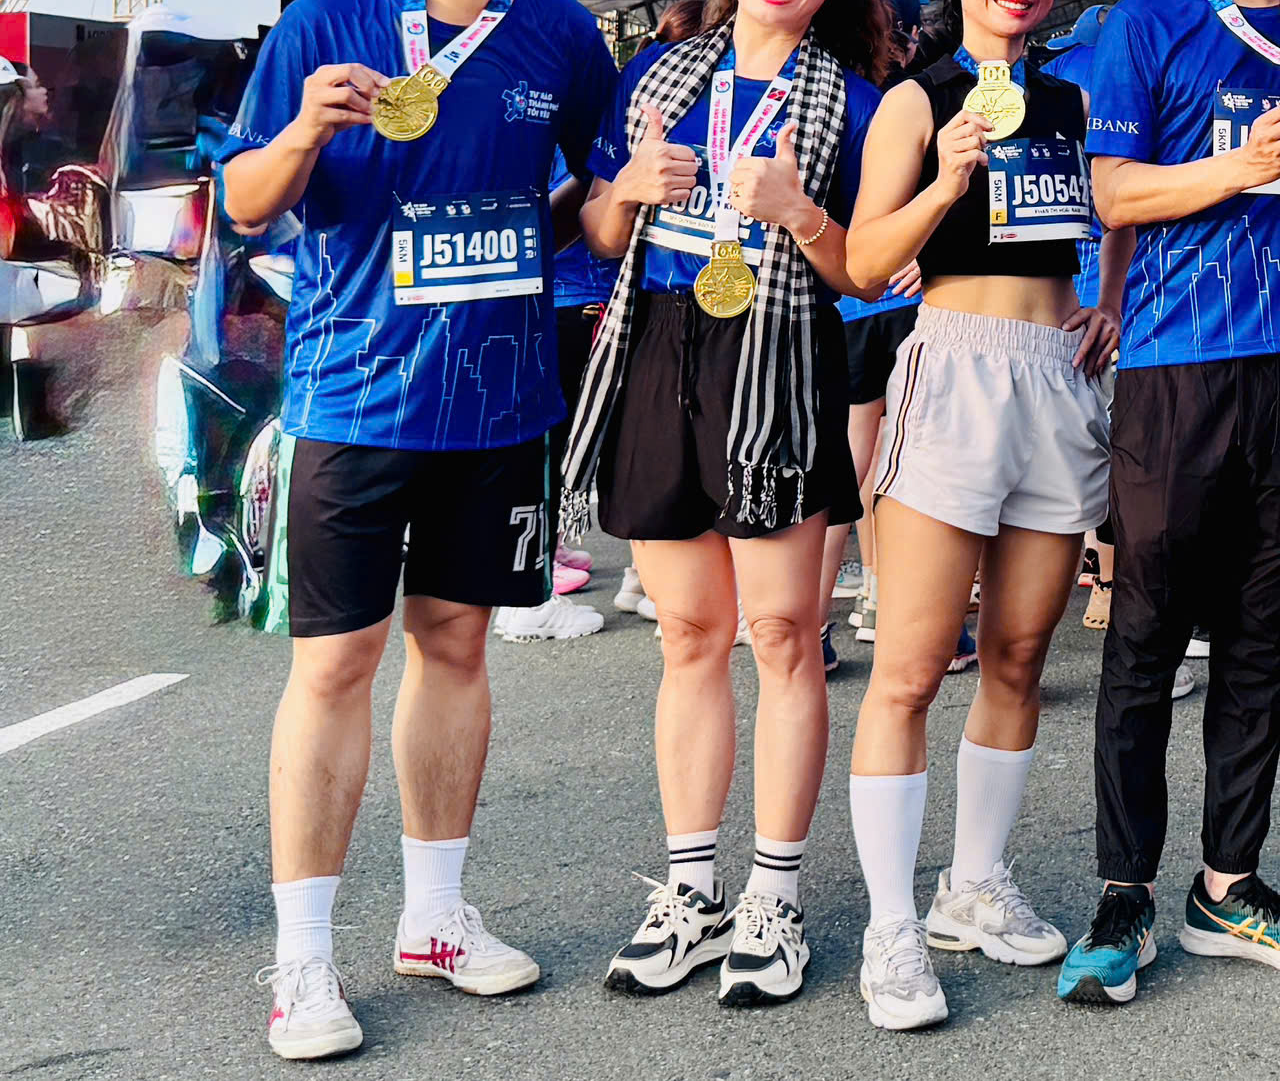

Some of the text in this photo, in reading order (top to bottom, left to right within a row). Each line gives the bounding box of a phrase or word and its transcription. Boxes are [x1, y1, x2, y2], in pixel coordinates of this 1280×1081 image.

[1218, 128, 1227, 151] 5KM
[994, 179, 1003, 203] 5KM
[995, 212, 1003, 221] F
[398, 239, 408, 263] 5KM
[419, 228, 518, 266] J51400
